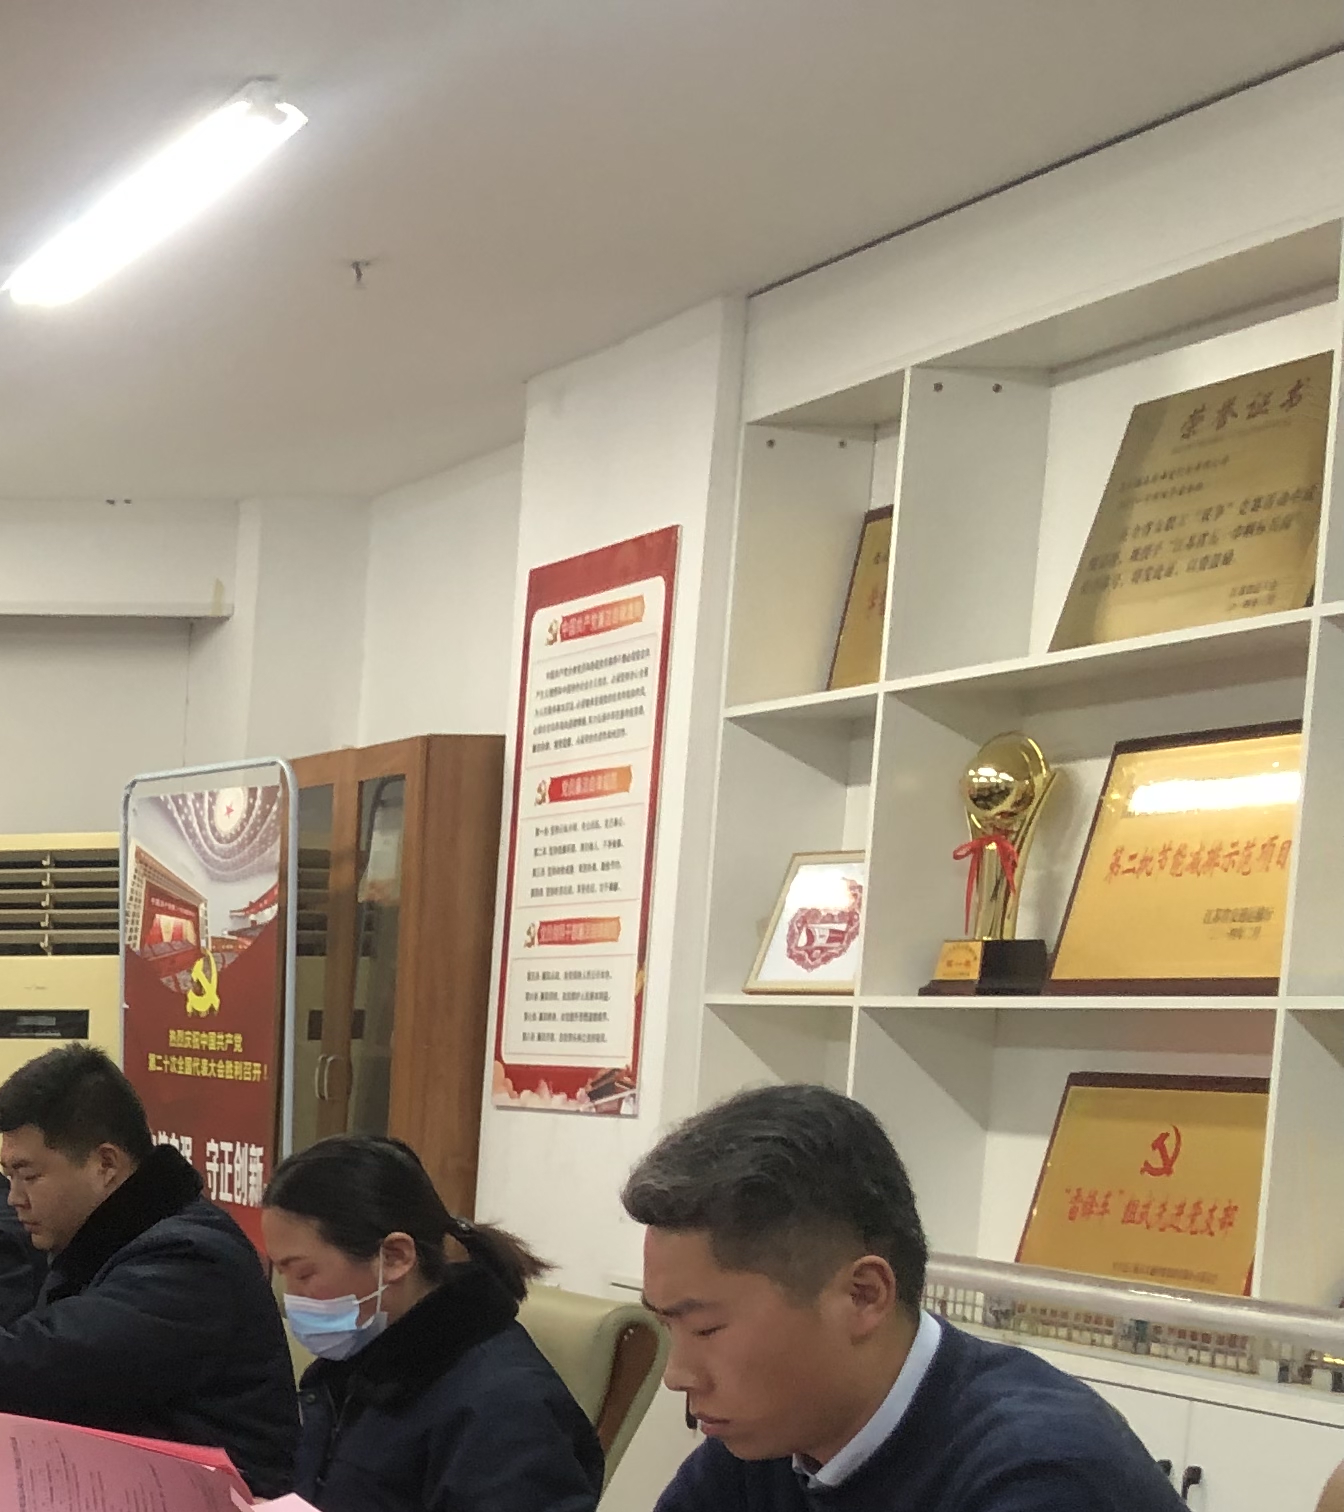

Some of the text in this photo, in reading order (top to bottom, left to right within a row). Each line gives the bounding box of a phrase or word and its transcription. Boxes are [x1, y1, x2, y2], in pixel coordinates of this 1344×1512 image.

[168, 1029, 243, 1052] 热烈庆祝中国共产党
